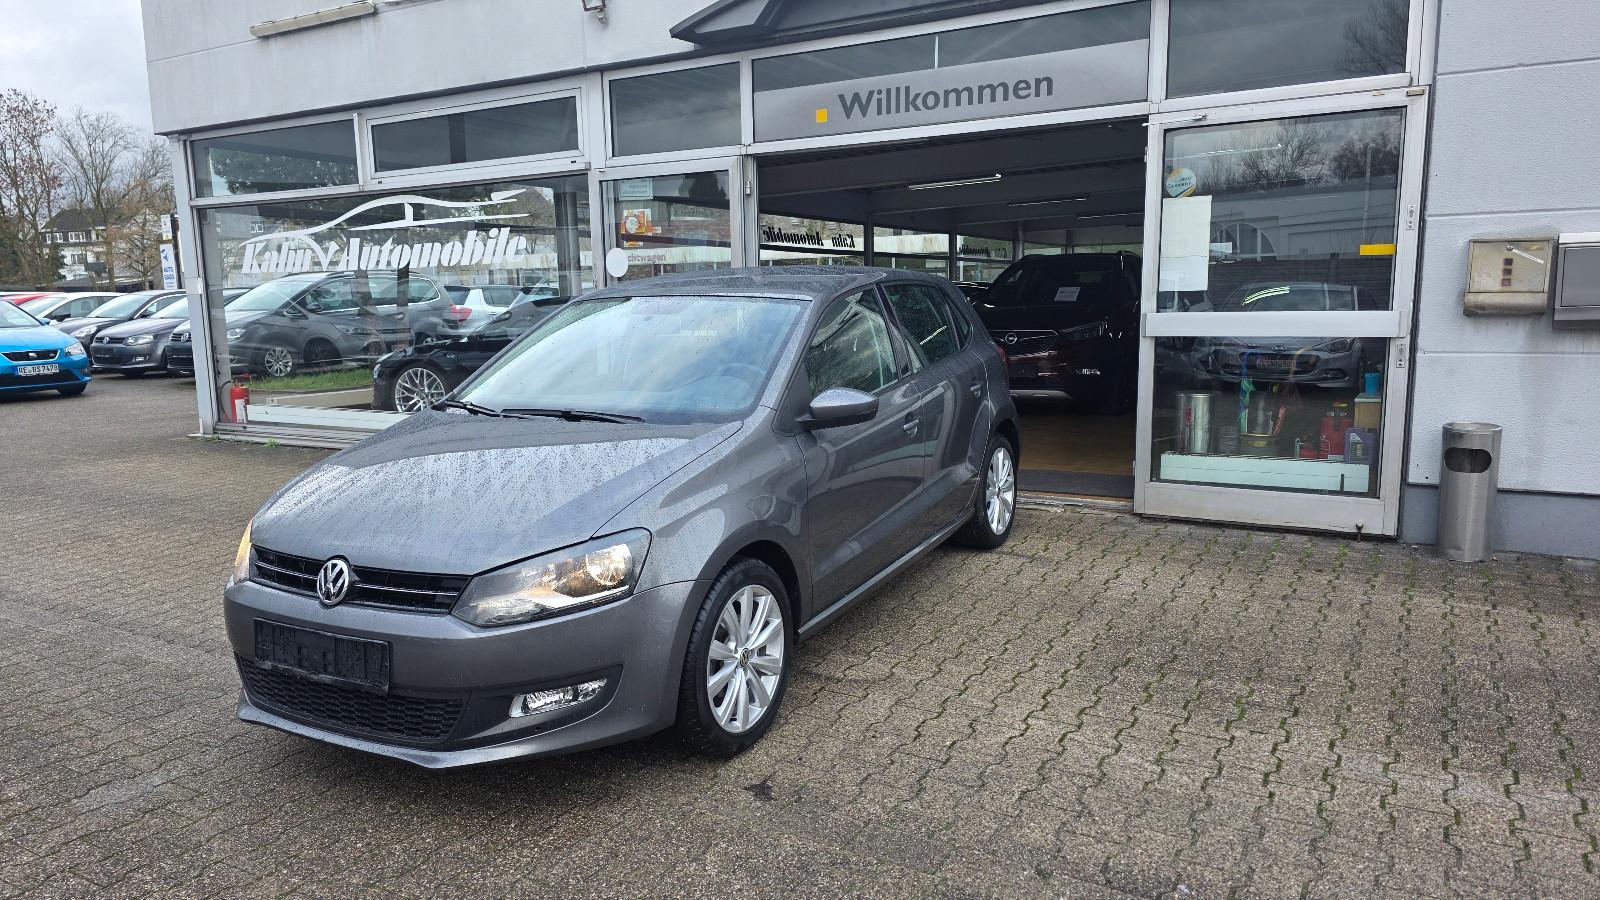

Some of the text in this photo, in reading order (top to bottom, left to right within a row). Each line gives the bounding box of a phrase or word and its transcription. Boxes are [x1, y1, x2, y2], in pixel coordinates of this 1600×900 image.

[837, 75, 1054, 120] Willkommen
[241, 226, 527, 273] Kahn Automobile
[627, 252, 667, 264] chtwagen
[317, 559, 349, 606] VW
